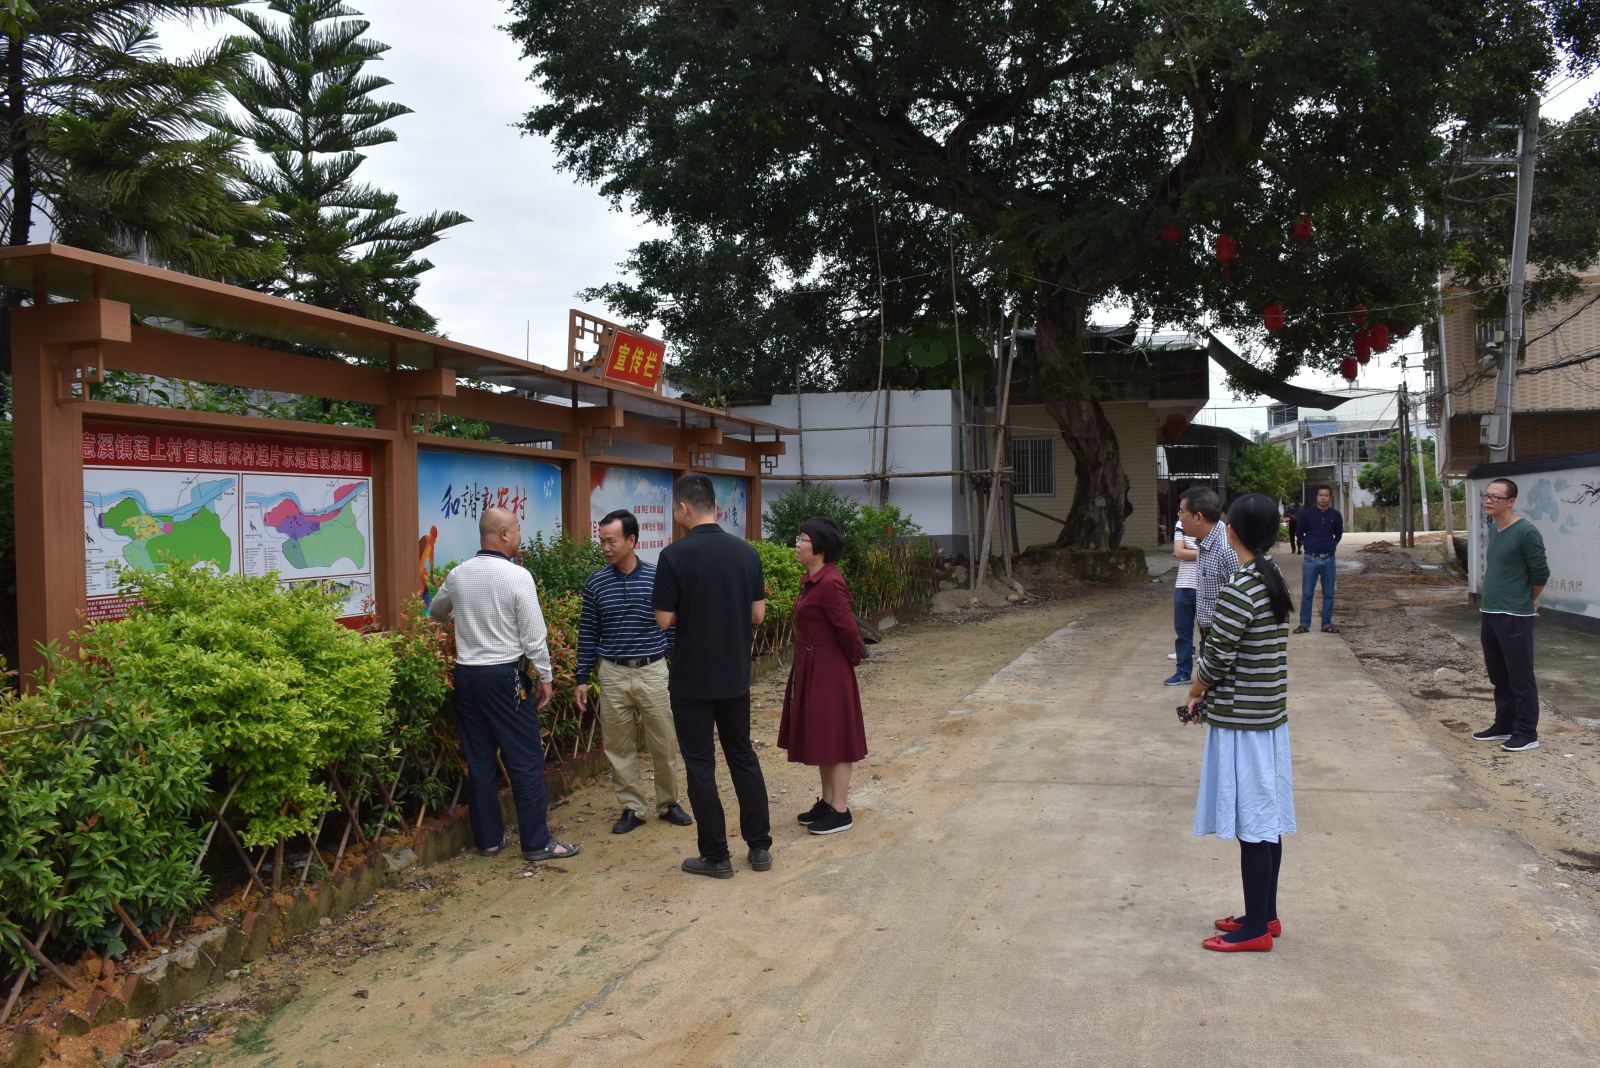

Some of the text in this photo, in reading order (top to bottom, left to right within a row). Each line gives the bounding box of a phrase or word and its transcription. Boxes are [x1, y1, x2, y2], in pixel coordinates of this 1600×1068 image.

[613, 343, 658, 378] 宣传栏
[82, 432, 364, 471] 意溪镇莲上村省级新农村连片示范建设规划图
[441, 482, 528, 521] 和谐新农村
